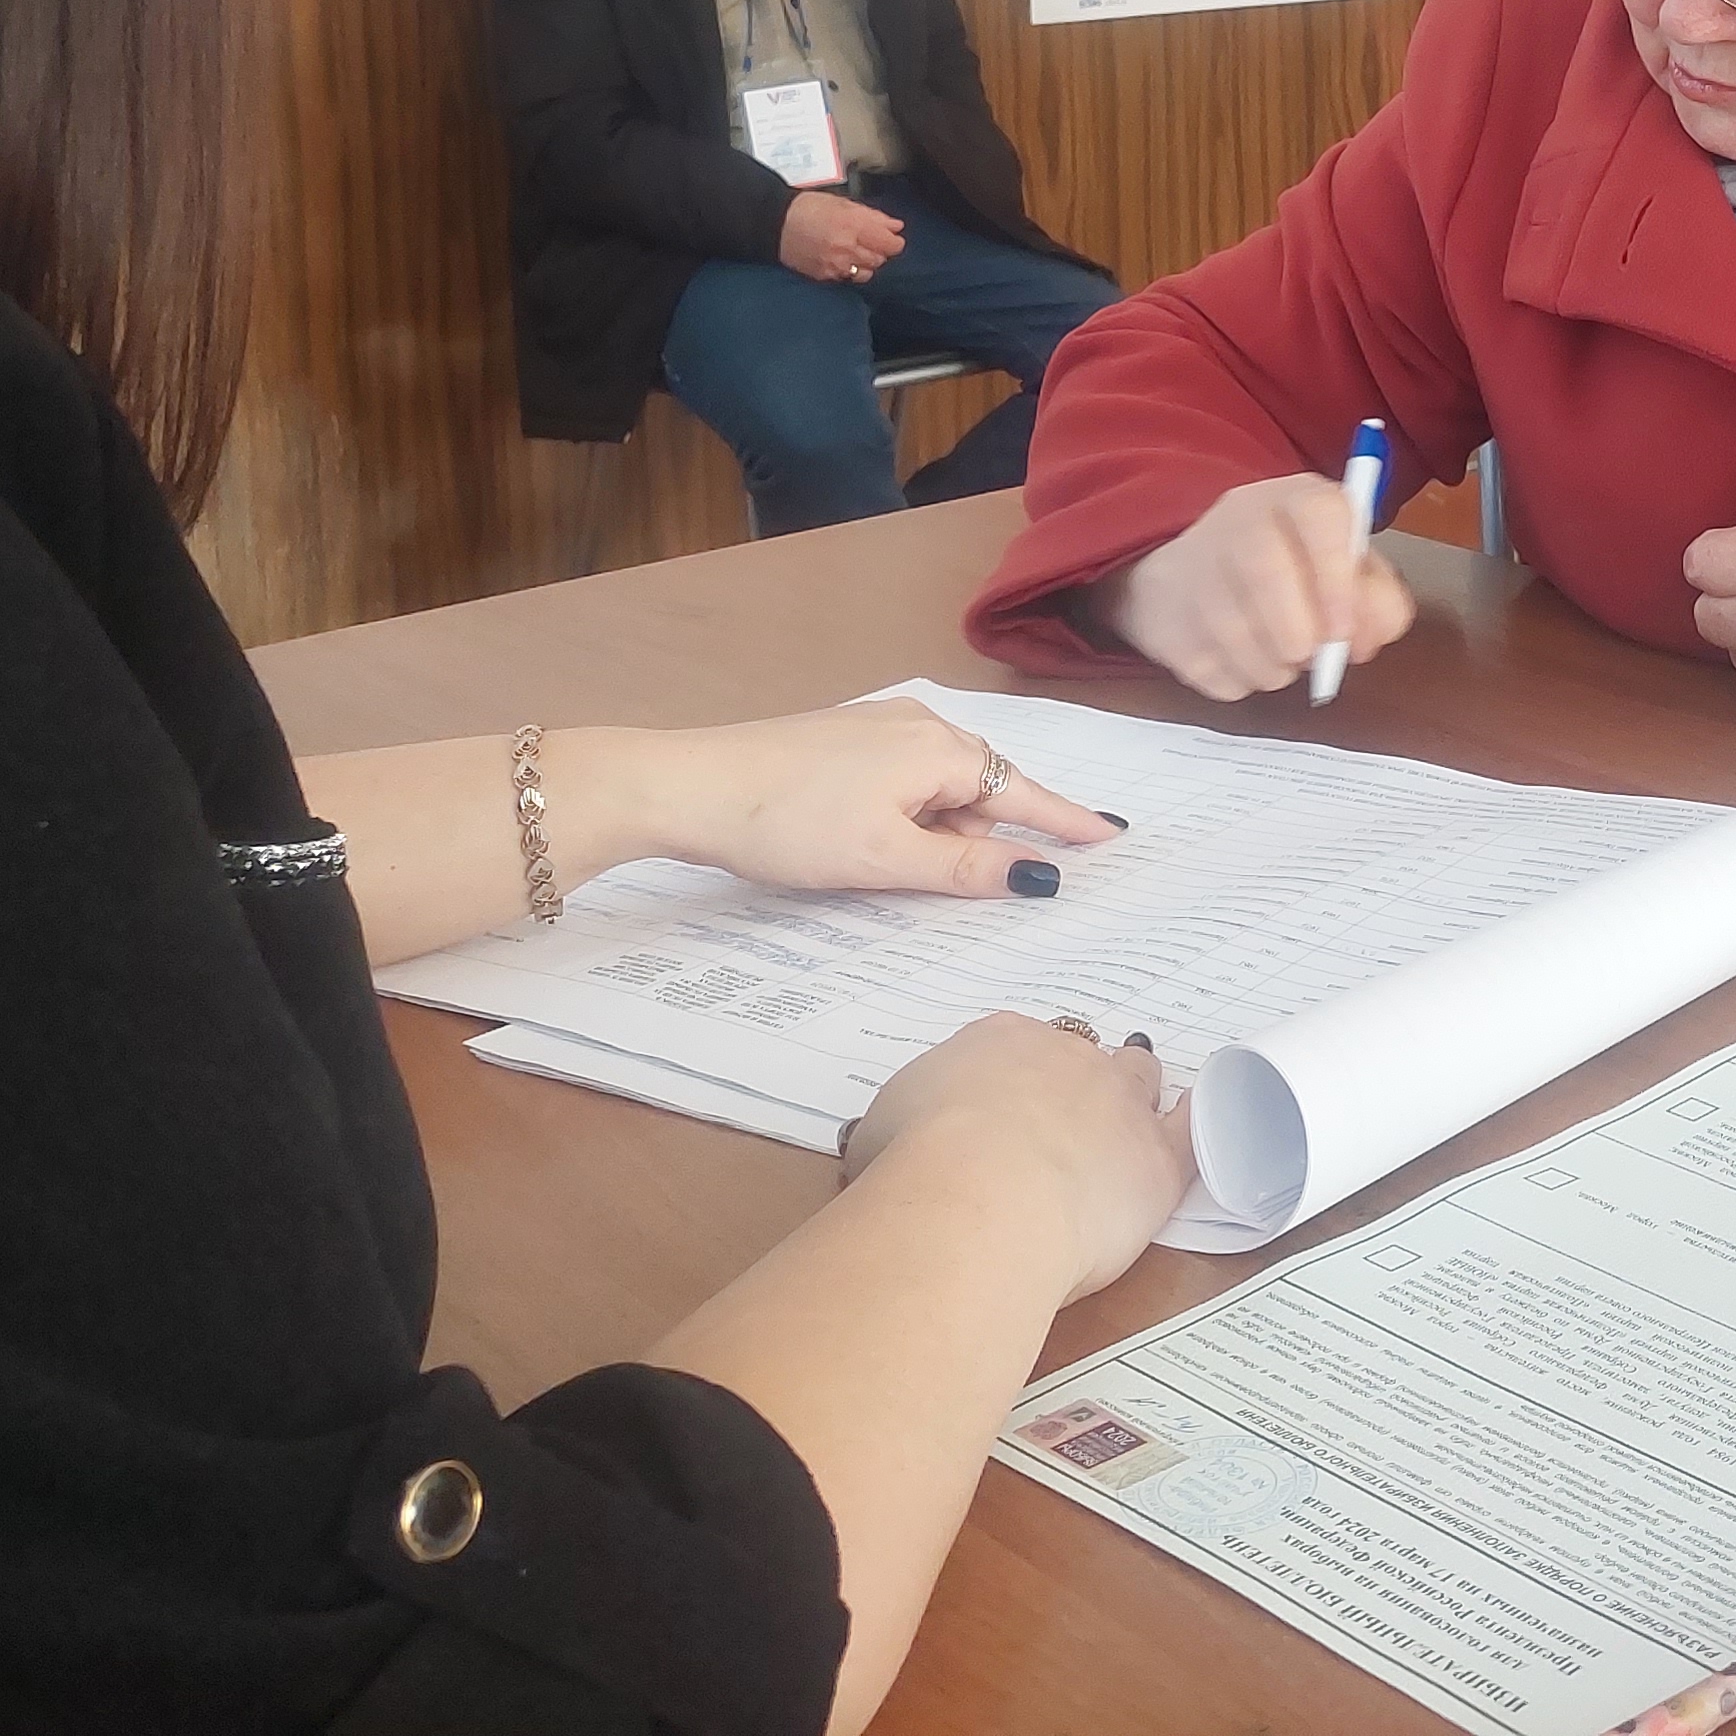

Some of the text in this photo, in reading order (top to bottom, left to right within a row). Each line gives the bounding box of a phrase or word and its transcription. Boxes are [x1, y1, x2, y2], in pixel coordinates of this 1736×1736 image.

[1097, 1423, 1139, 1447] 2024
[1233, 1407, 1319, 1452] БЮЛЛЕТЕНЯ
[1312, 1447, 1438, 1514] ИЗБИРАТЕЛЬНОГО
[1428, 1508, 1529, 1562] ЗАПОЛНЕНИЯ
[1278, 1504, 1584, 1678] Президента Российской Федерации,
[1279, 1533, 1530, 1671] для голосования на выборах
[1299, 1495, 1604, 1659] назначенных на 17 марта 2024 года
[1521, 1556, 1597, 1597] ПОРЯДКЕ
[1591, 1592, 1609, 1604] О
[1219, 1533, 1530, 1714] ИЗБИРАТЕЛЬНЫЙ БЮЛЛЕТЕНЬ
[1602, 1598, 1724, 1660] РАЗЪЯСНЕНИЕ
